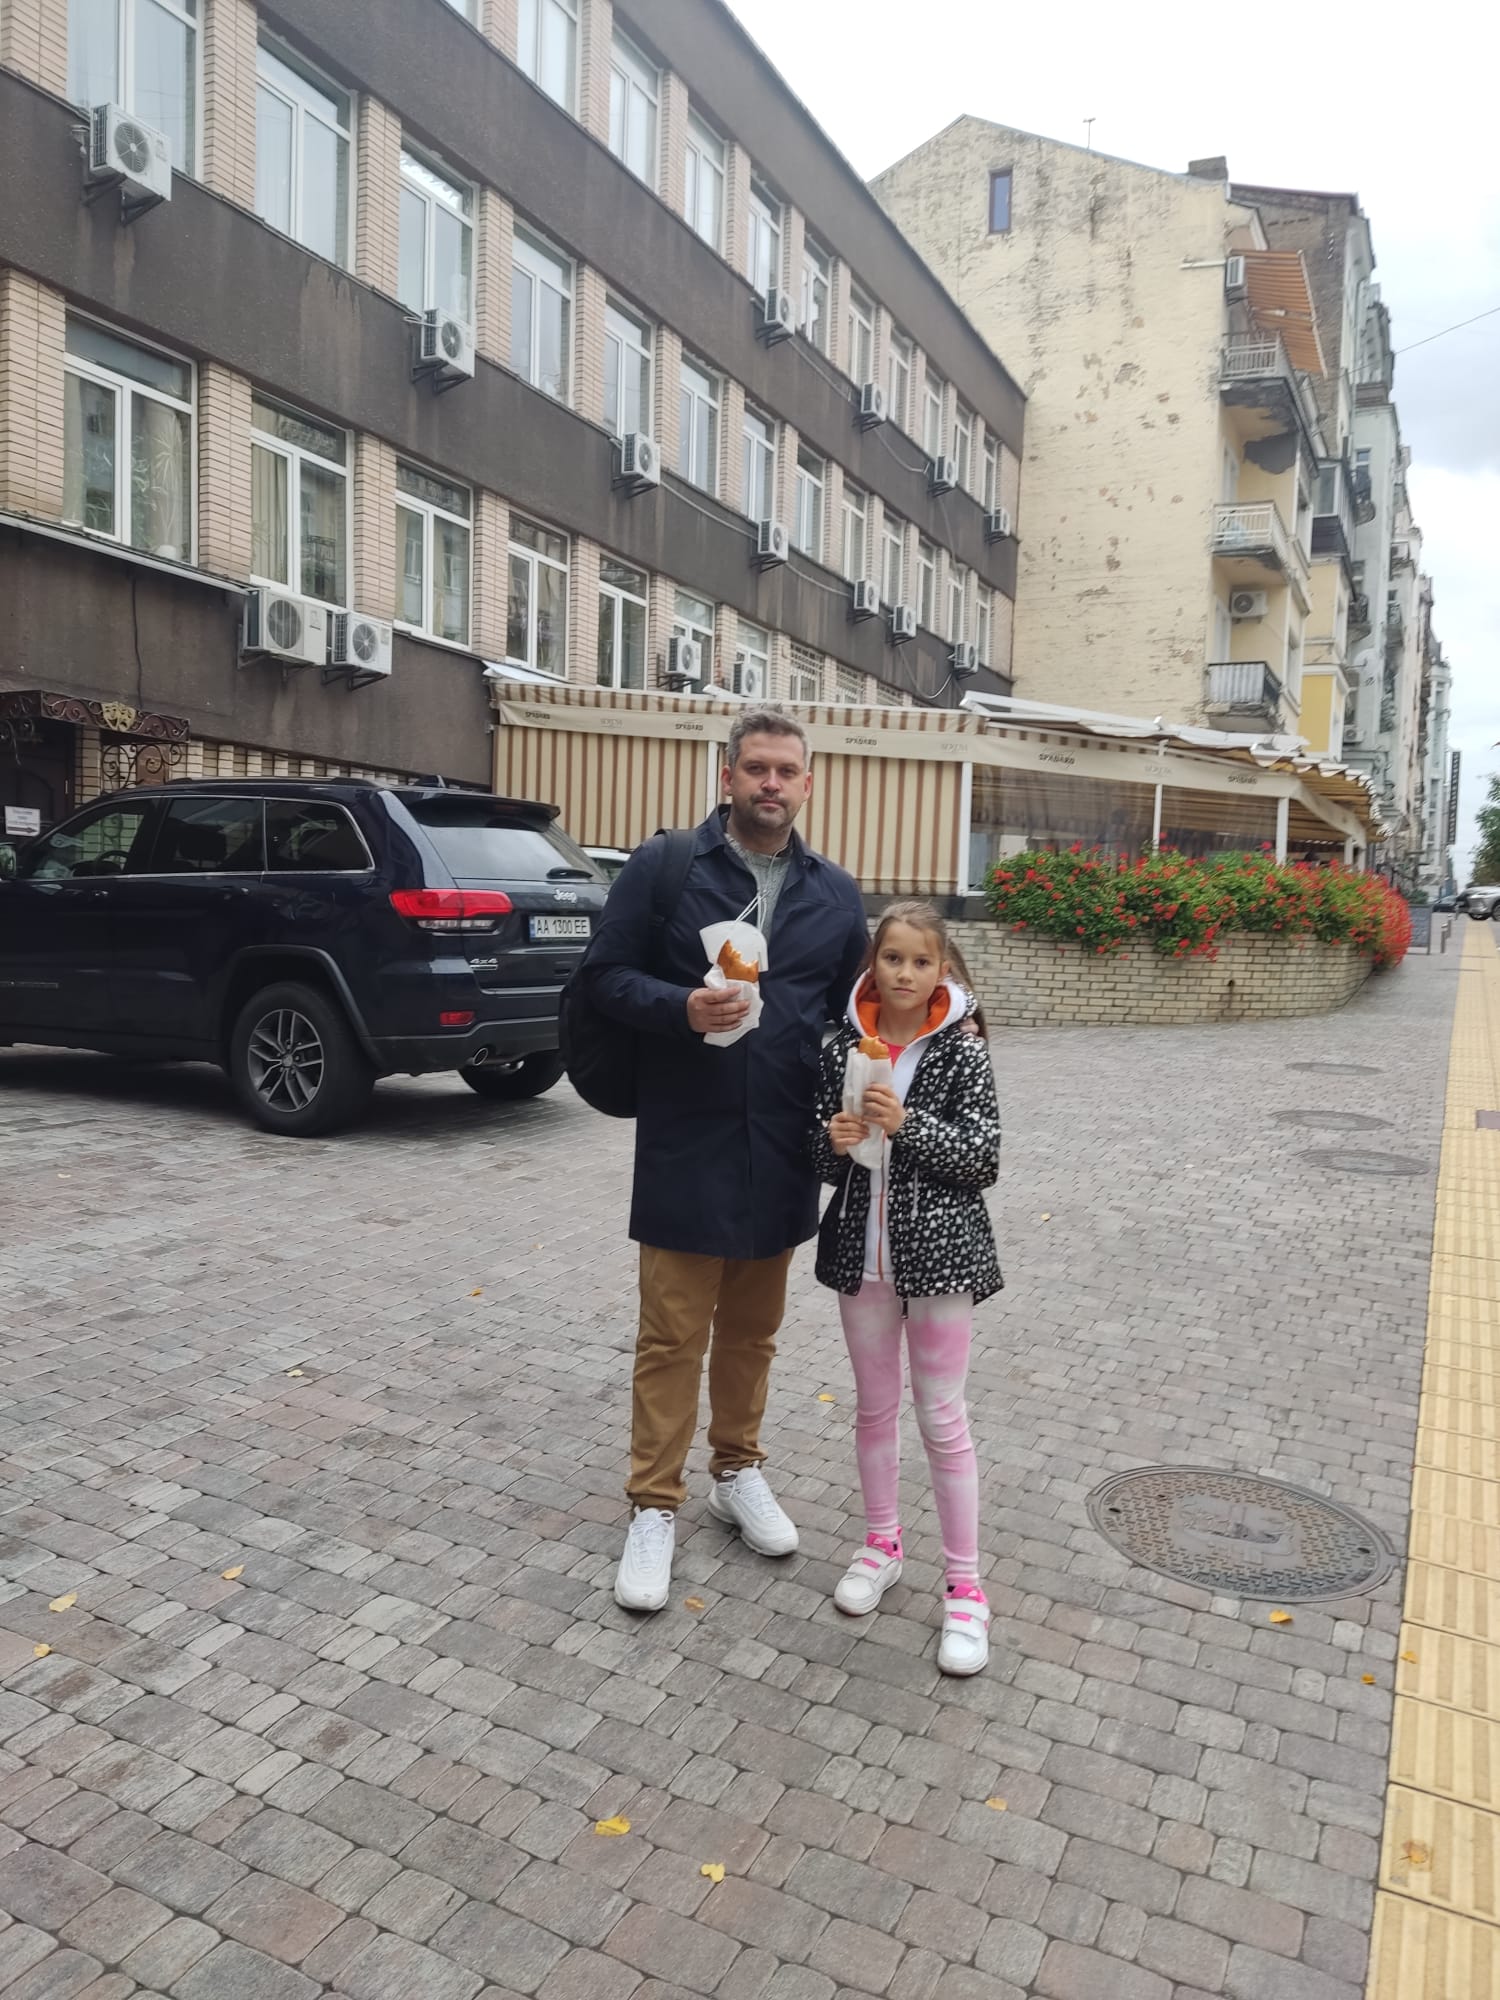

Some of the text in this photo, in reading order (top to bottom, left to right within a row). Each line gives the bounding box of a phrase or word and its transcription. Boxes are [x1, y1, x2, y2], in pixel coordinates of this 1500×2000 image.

[553, 888, 577, 904] Jeep
[537, 919, 588, 934] AA 1300 EE
